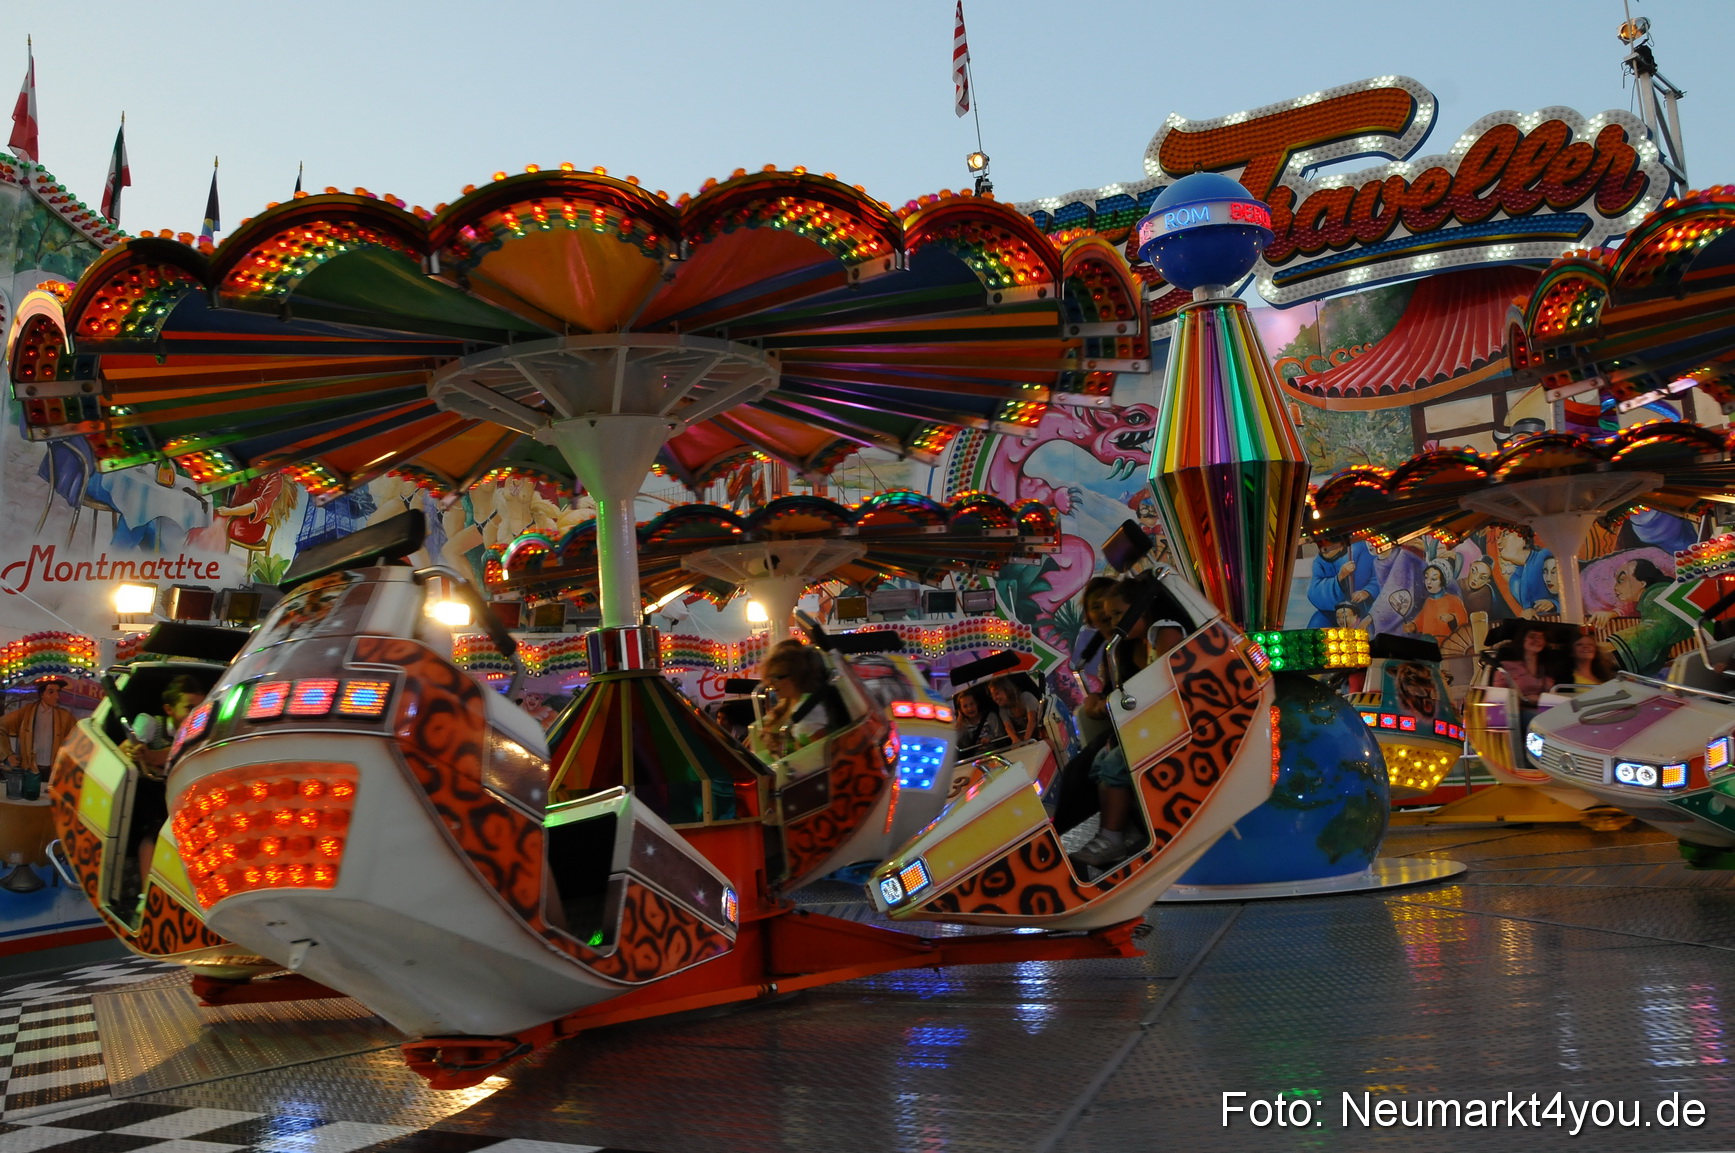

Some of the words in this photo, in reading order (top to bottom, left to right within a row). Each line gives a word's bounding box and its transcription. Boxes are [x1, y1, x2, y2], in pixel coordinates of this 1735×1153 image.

[1158, 87, 1648, 263] Traveller
[1163, 205, 1211, 230] ROM
[0, 544, 221, 595] Montmartre
